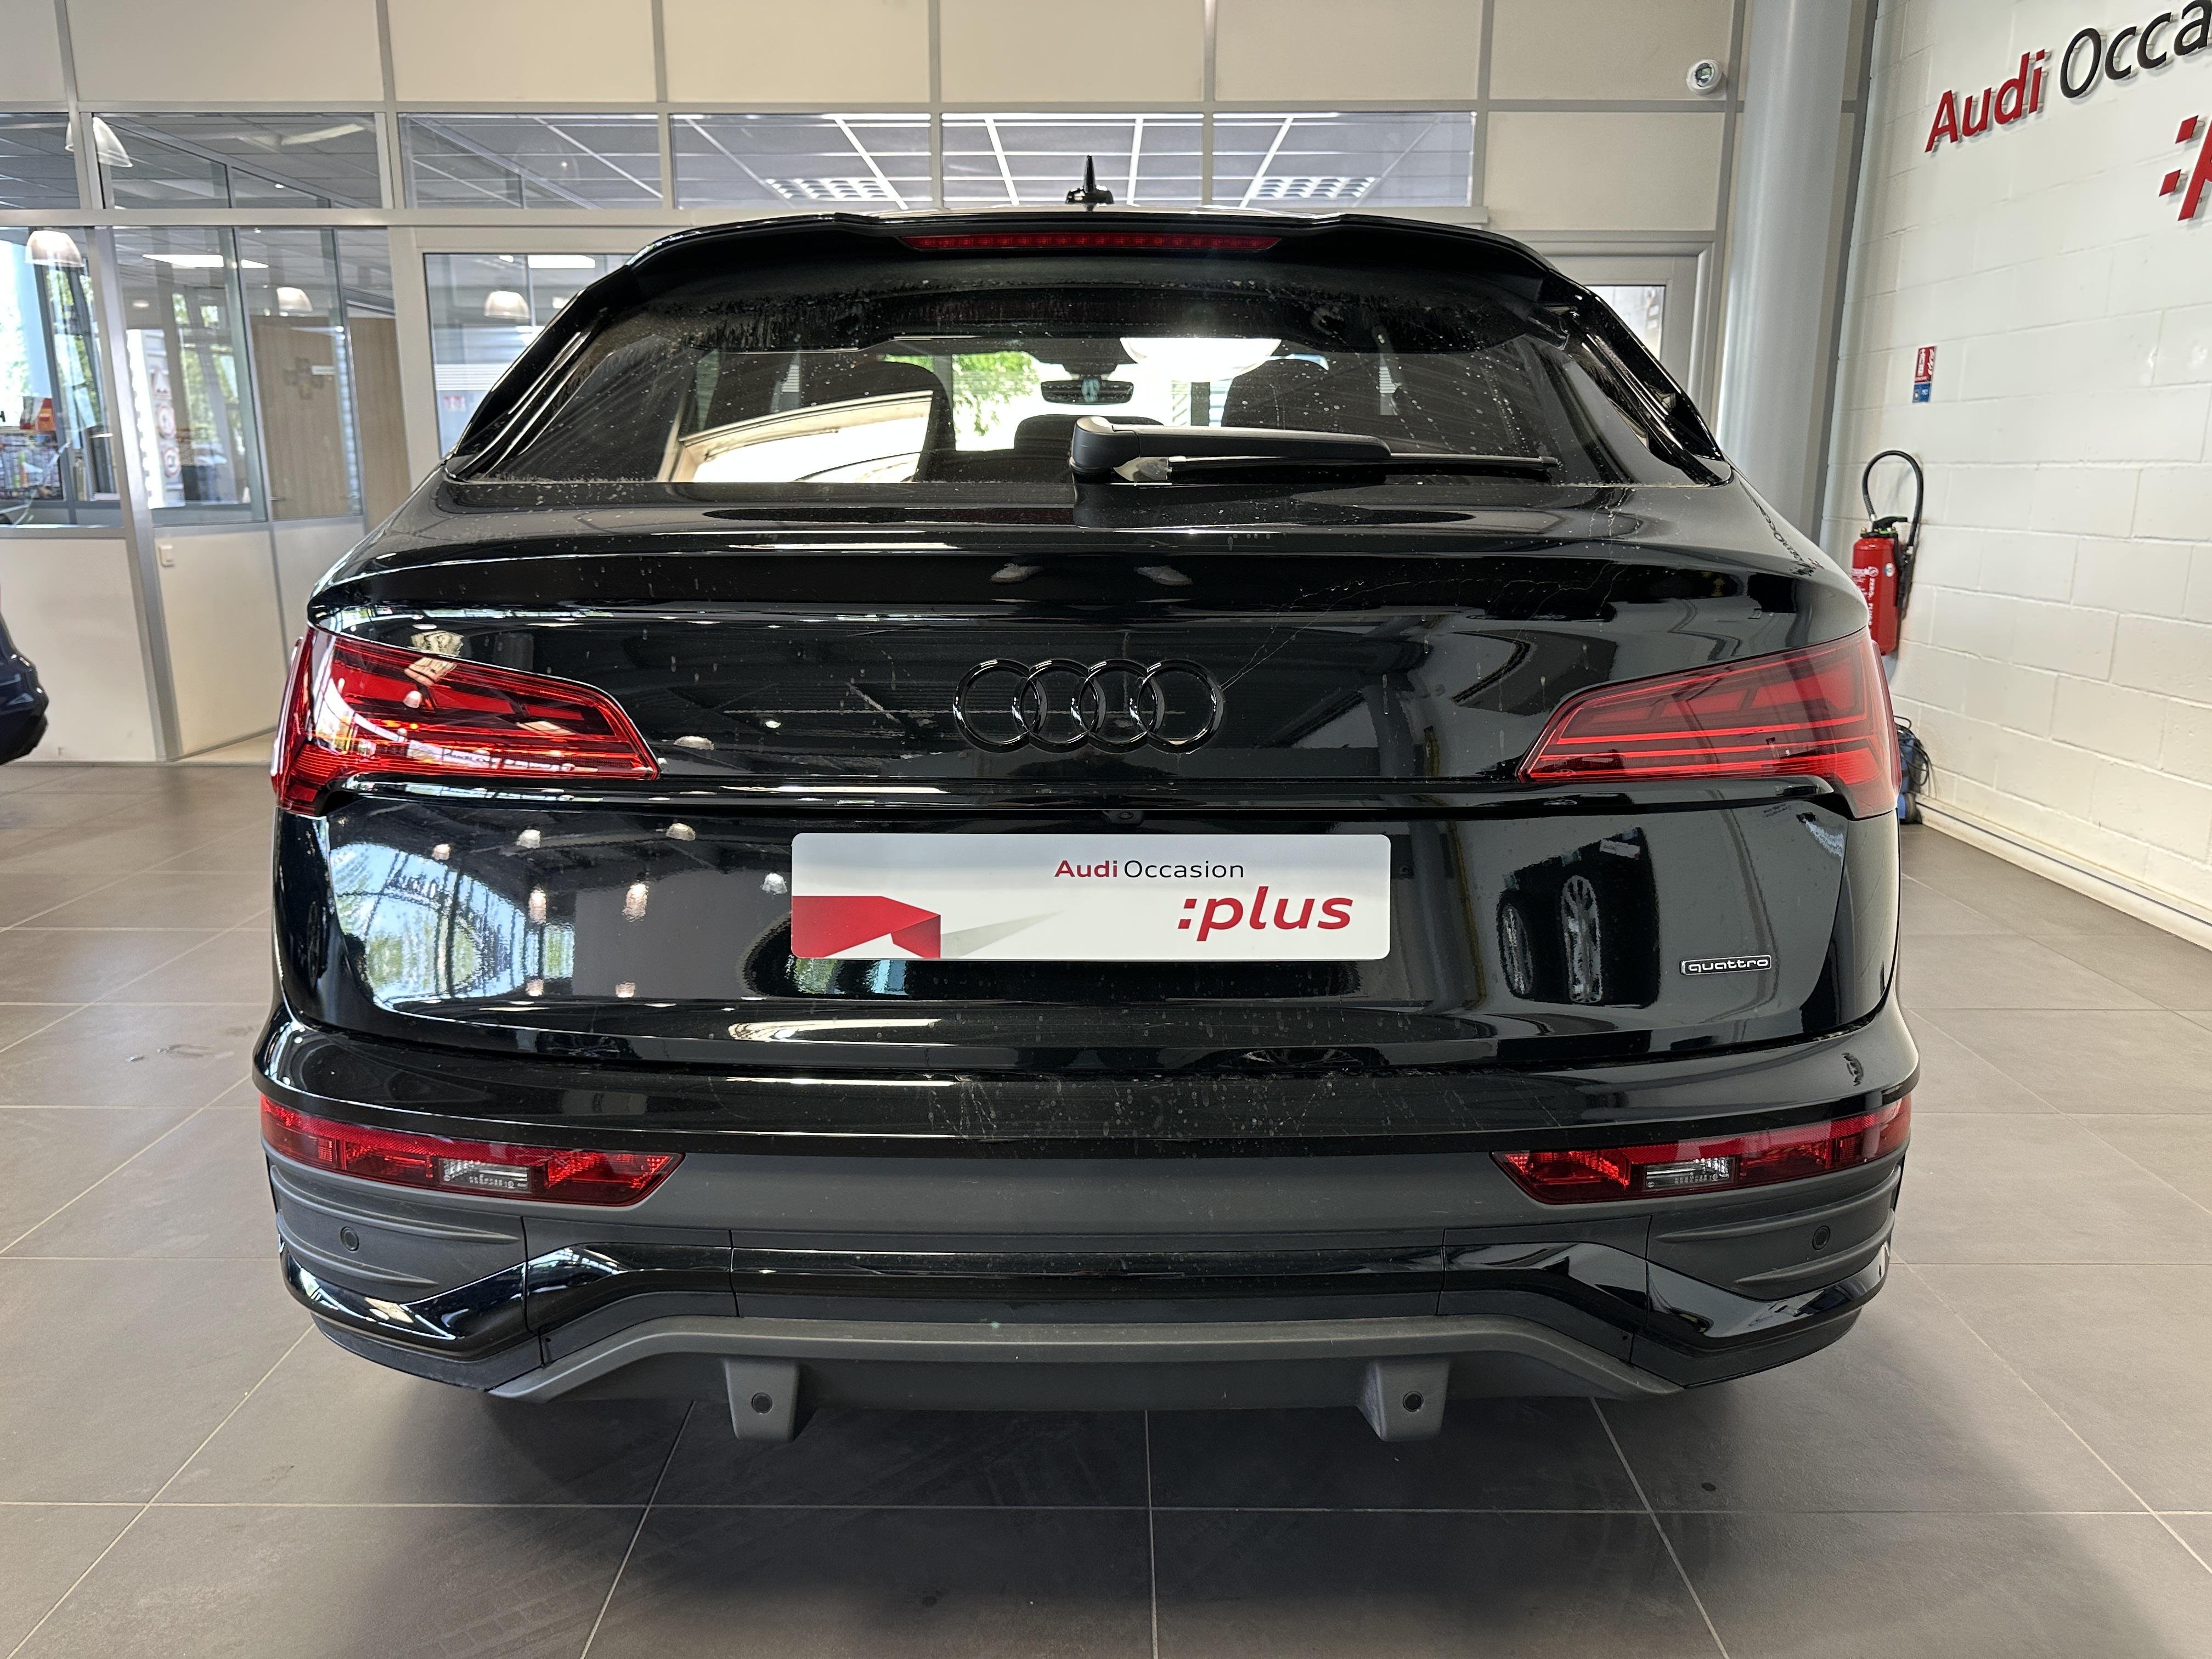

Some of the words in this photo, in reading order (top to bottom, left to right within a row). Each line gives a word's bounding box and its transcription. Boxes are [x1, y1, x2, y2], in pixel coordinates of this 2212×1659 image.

[1925, 49, 2045, 153] Audi
[2060, 0, 2212, 98] Occa
[1054, 860, 1118, 877] Audi
[1124, 860, 1244, 878] Occasion
[1178, 886, 1353, 941] :plus
[1689, 960, 1769, 973] quattro
